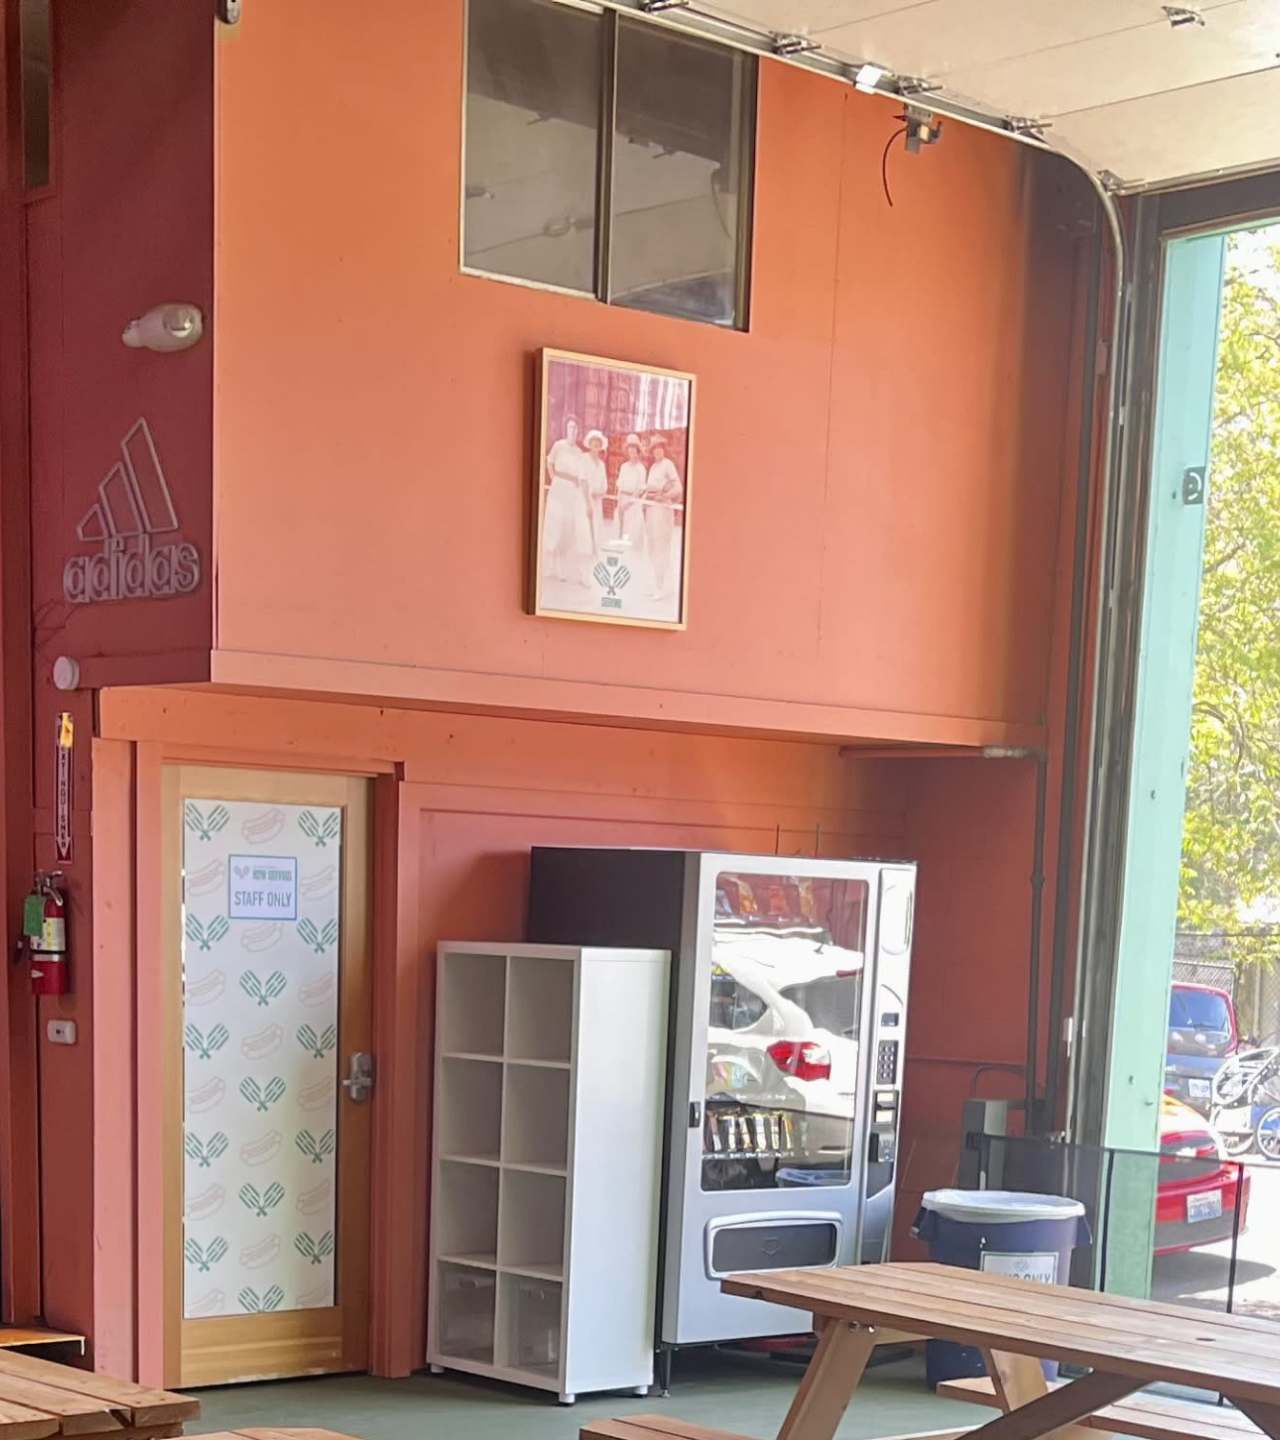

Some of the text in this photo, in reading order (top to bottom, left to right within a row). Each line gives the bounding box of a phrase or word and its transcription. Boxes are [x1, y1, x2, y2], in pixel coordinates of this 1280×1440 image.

[63, 533, 200, 604] adidas
[234, 890, 291, 908] STAFF ONLY
